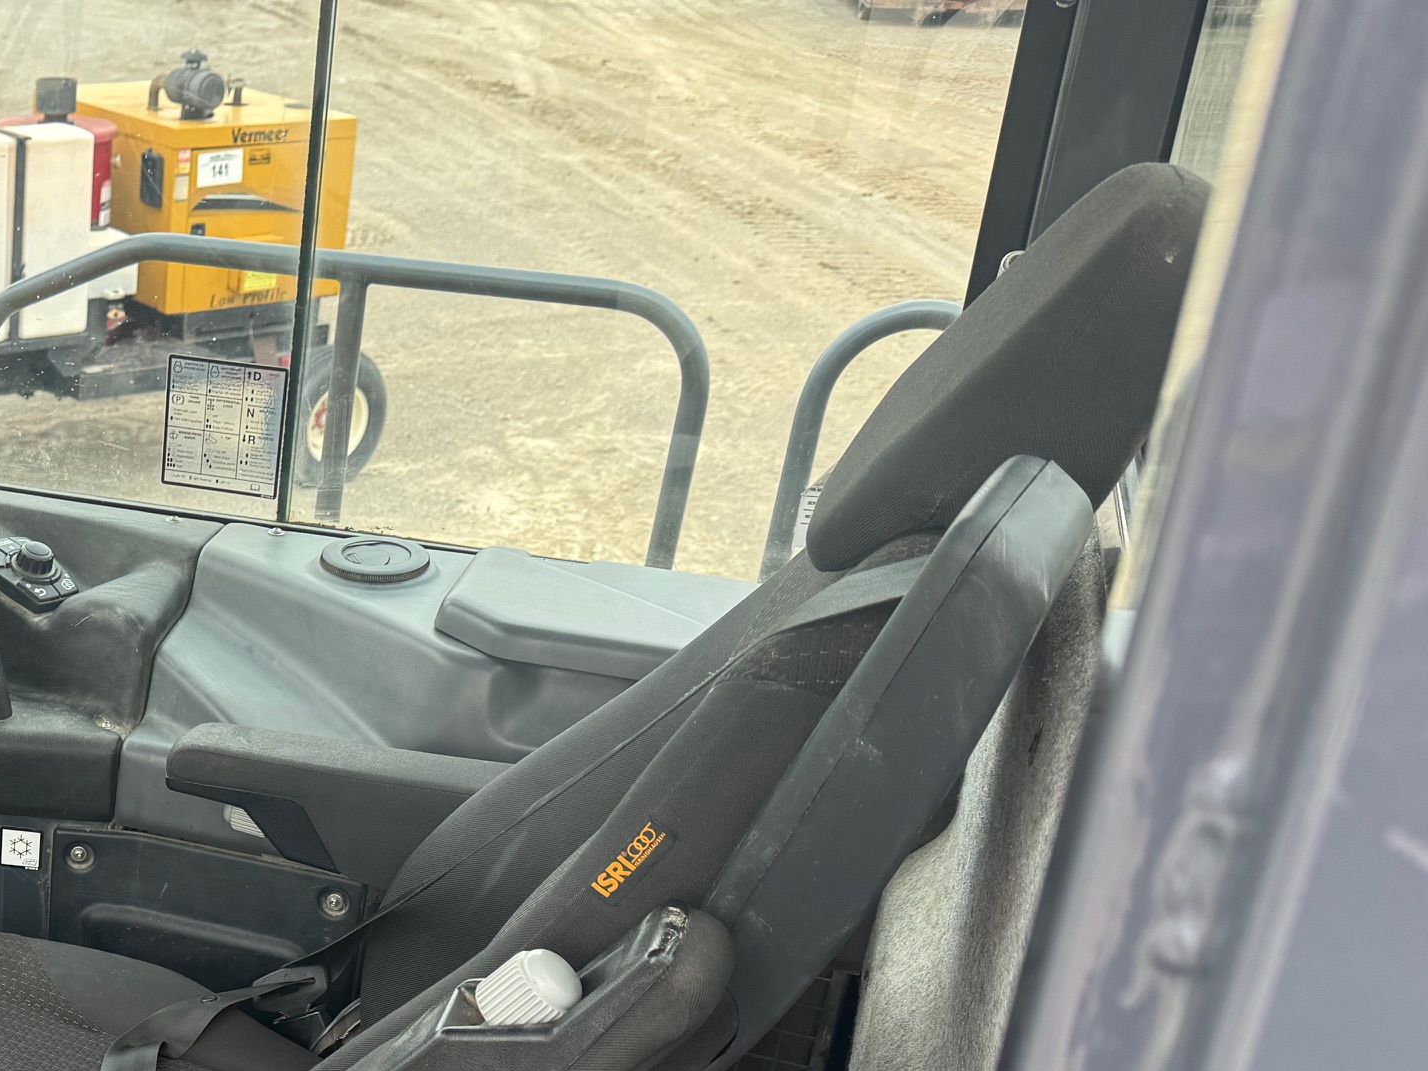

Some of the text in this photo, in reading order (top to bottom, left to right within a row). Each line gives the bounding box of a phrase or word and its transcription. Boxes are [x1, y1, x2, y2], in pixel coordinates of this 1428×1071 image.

[231, 128, 289, 144] Vermeer
[212, 163, 229, 177] 141
[253, 371, 262, 381] D
[246, 408, 255, 418] N
[248, 435, 256, 445] R
[590, 853, 637, 898] ISRI
